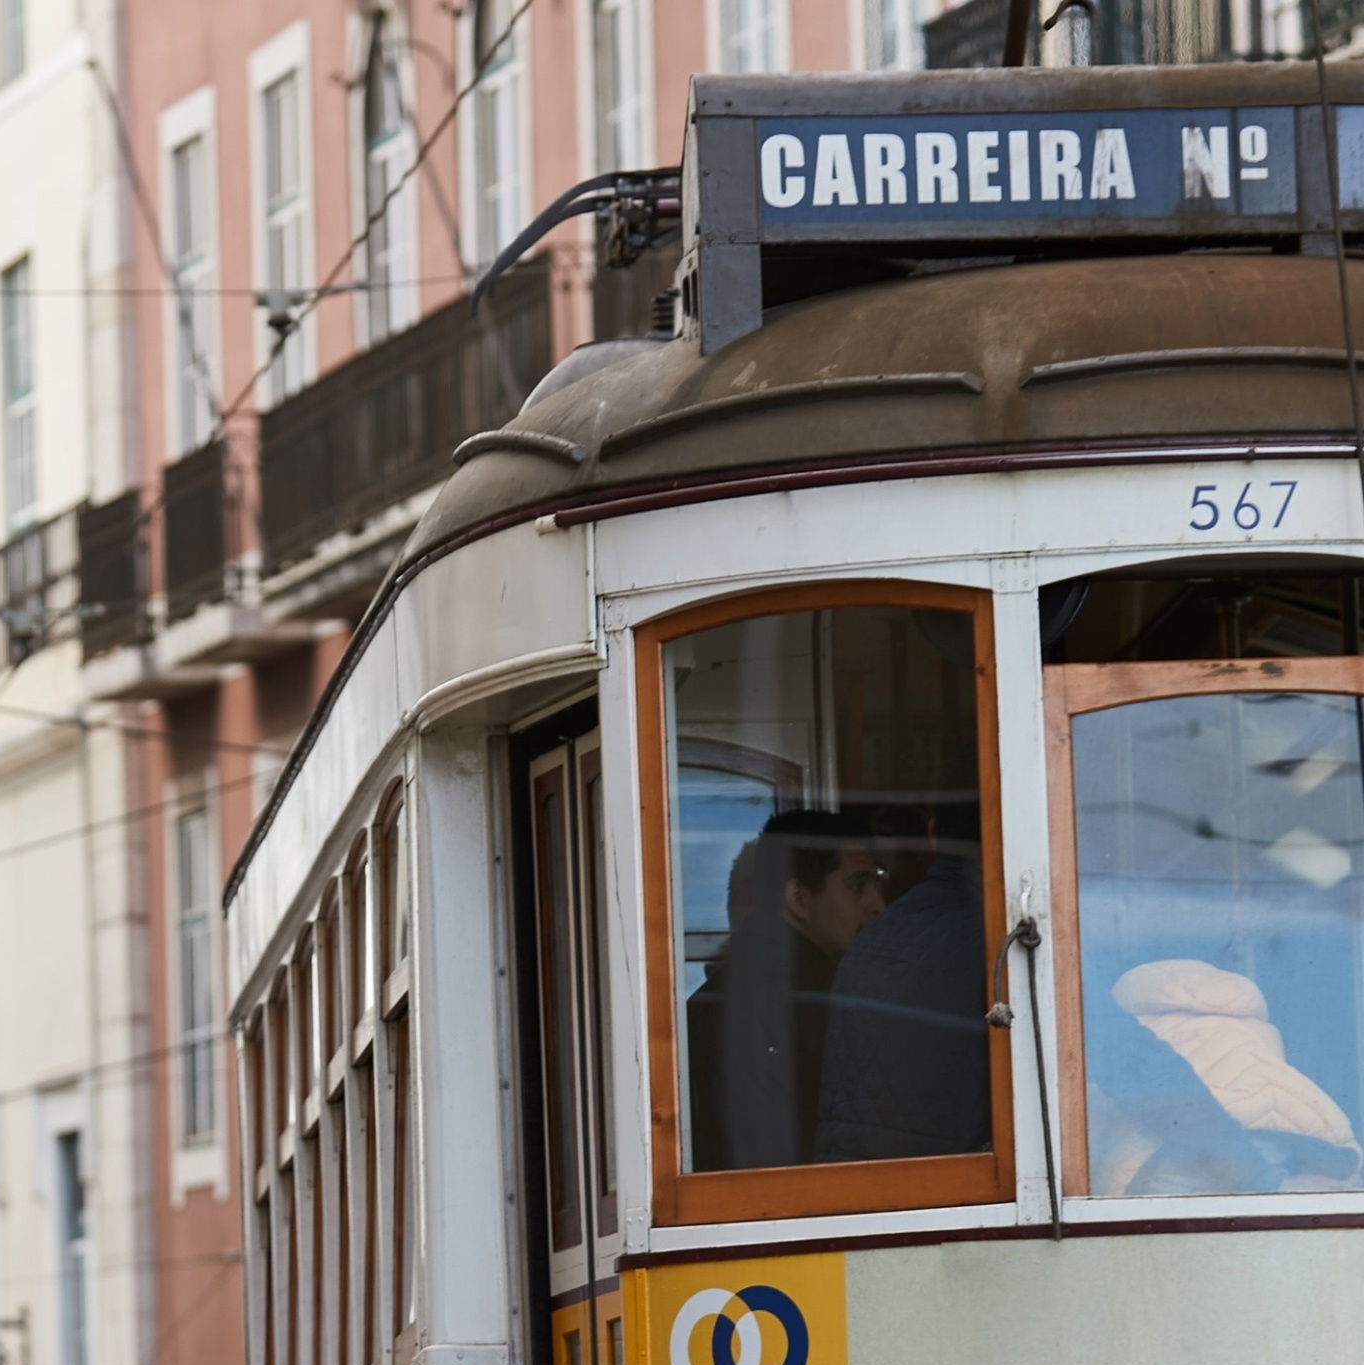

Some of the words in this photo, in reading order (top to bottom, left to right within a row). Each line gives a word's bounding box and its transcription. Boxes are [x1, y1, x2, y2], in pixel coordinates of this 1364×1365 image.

[760, 128, 1136, 208] CARREIRA
[1181, 125, 1269, 199] Nº
[1188, 480, 1298, 530] 567
